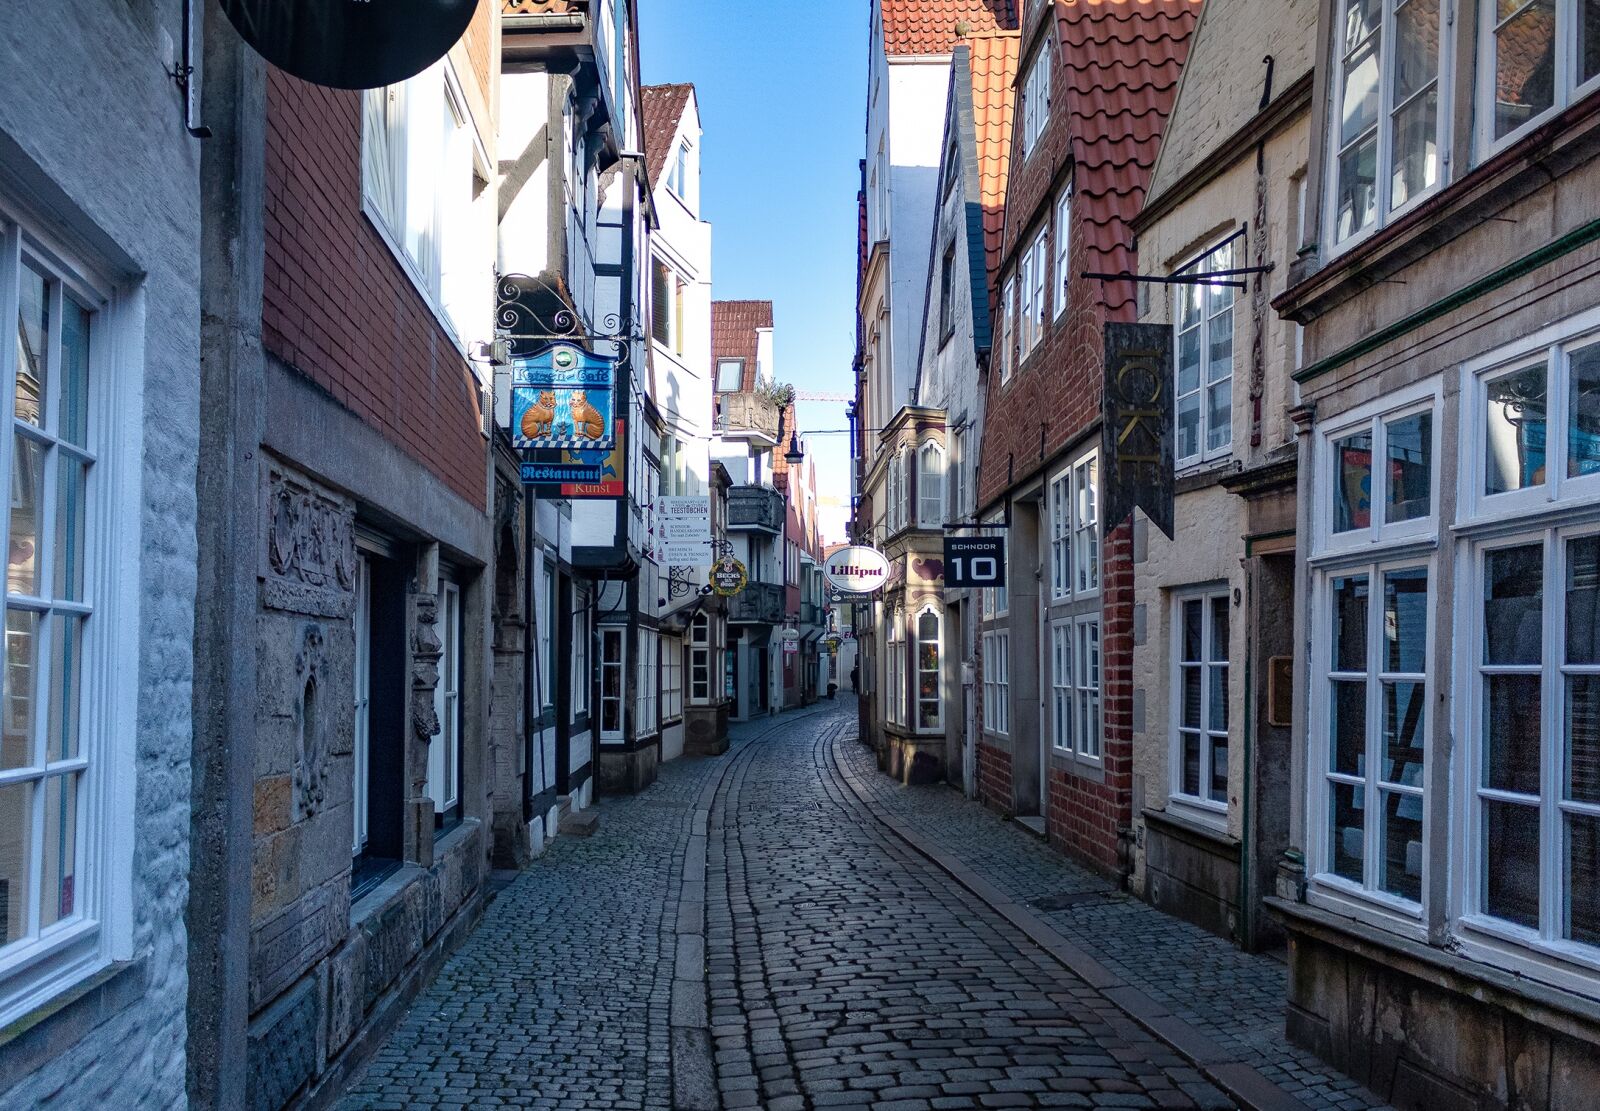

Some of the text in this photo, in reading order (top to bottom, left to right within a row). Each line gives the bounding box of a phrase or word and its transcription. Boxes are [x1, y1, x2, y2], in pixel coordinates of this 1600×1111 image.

[522, 466, 599, 479] Restaurant
[575, 483, 610, 493] Kunst
[830, 565, 883, 578] Lilliput
[951, 557, 997, 581] 10
